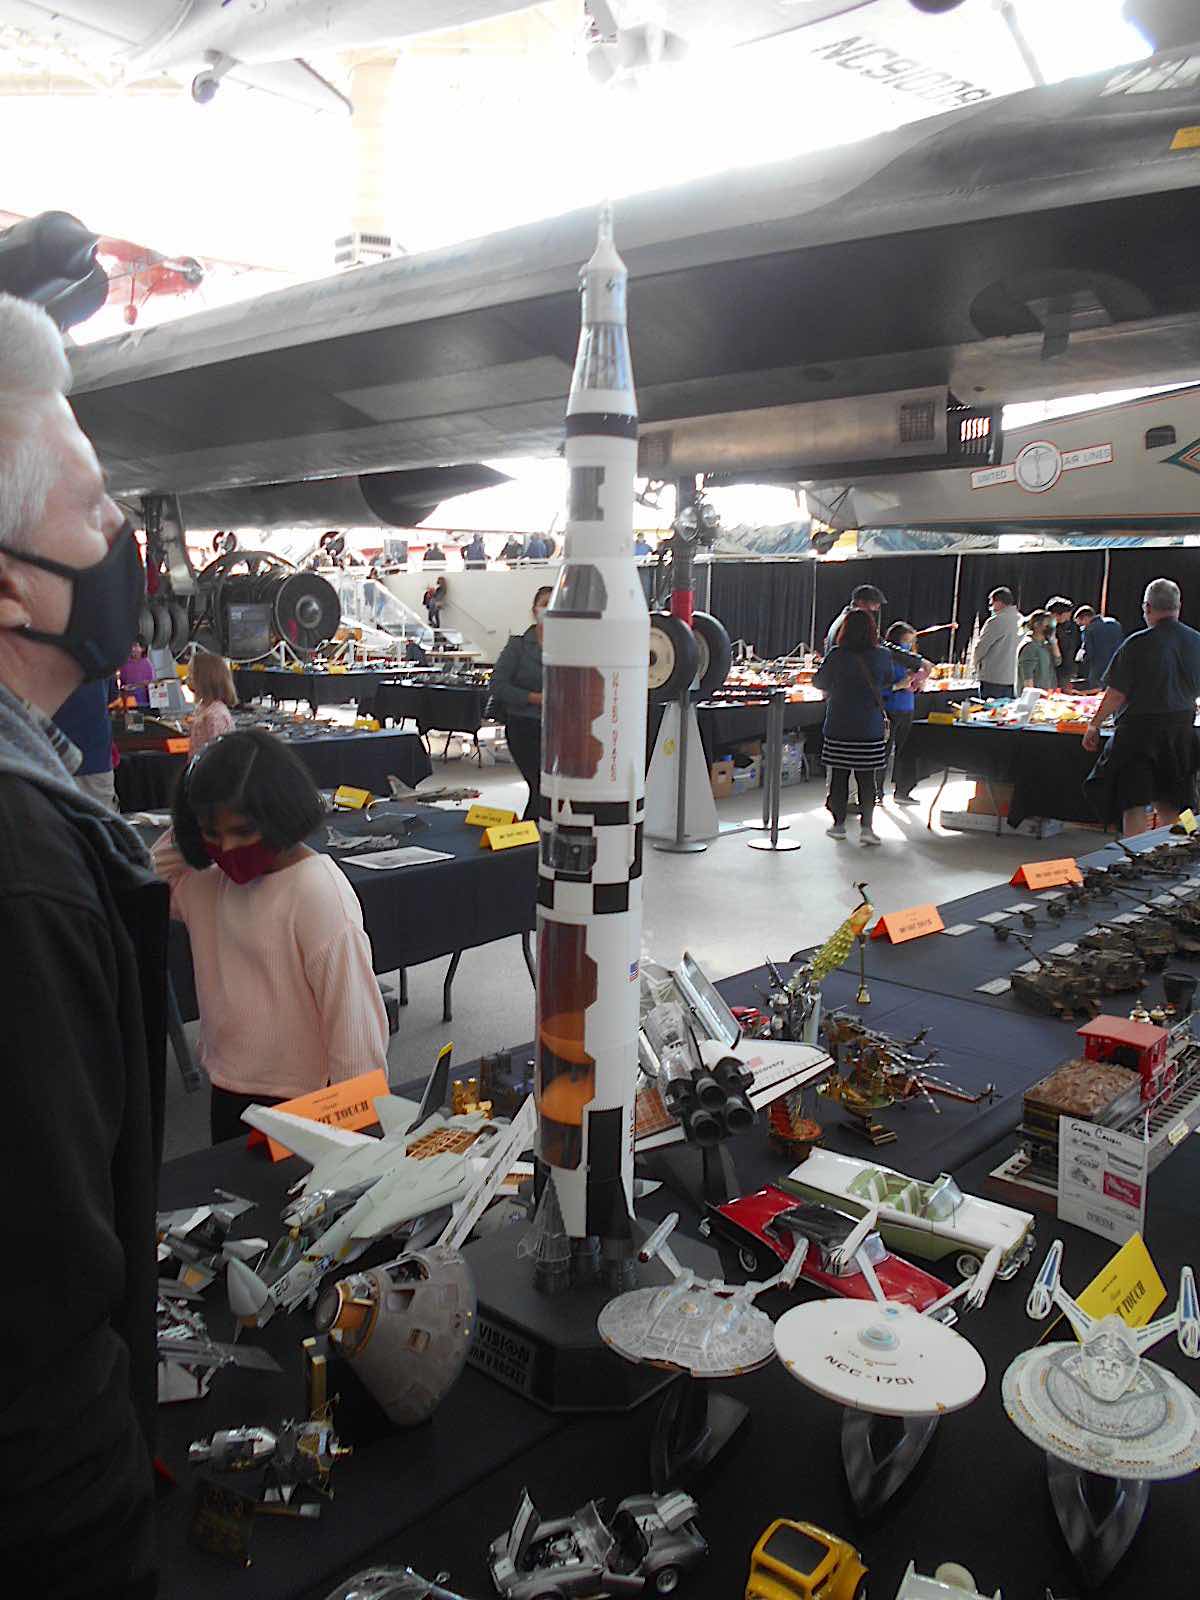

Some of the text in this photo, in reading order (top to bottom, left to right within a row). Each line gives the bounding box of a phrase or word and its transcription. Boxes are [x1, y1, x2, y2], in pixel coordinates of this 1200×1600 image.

[977, 448, 1111, 483] UNITED AIR LINES
[335, 1100, 369, 1121] TOUCH
